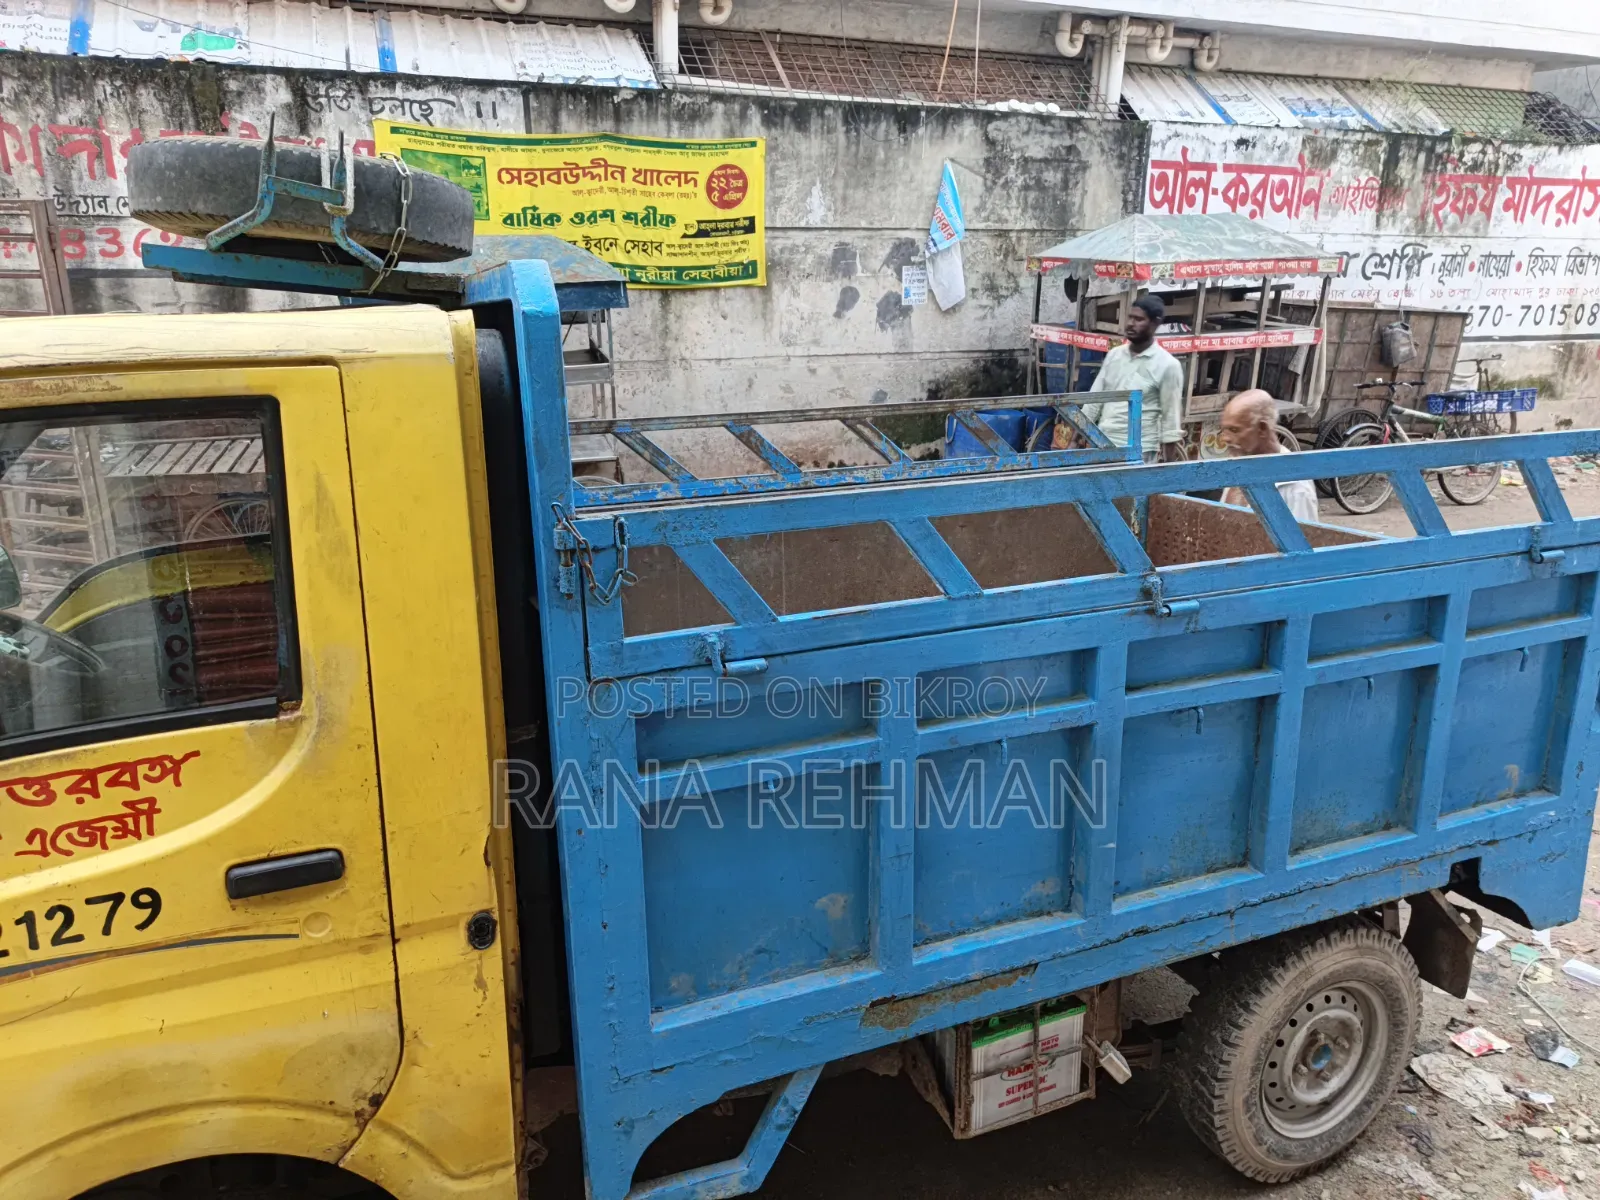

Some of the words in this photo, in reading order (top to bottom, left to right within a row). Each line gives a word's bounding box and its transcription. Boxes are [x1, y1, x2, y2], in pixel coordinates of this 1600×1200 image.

[368, 96, 456, 127] চলছে
[632, 168, 699, 188] খালেদ
[502, 205, 562, 227] বার্ষিক
[569, 209, 616, 226] ওরশ
[622, 205, 676, 228] শরীফ
[1211, 338, 1220, 346] মা
